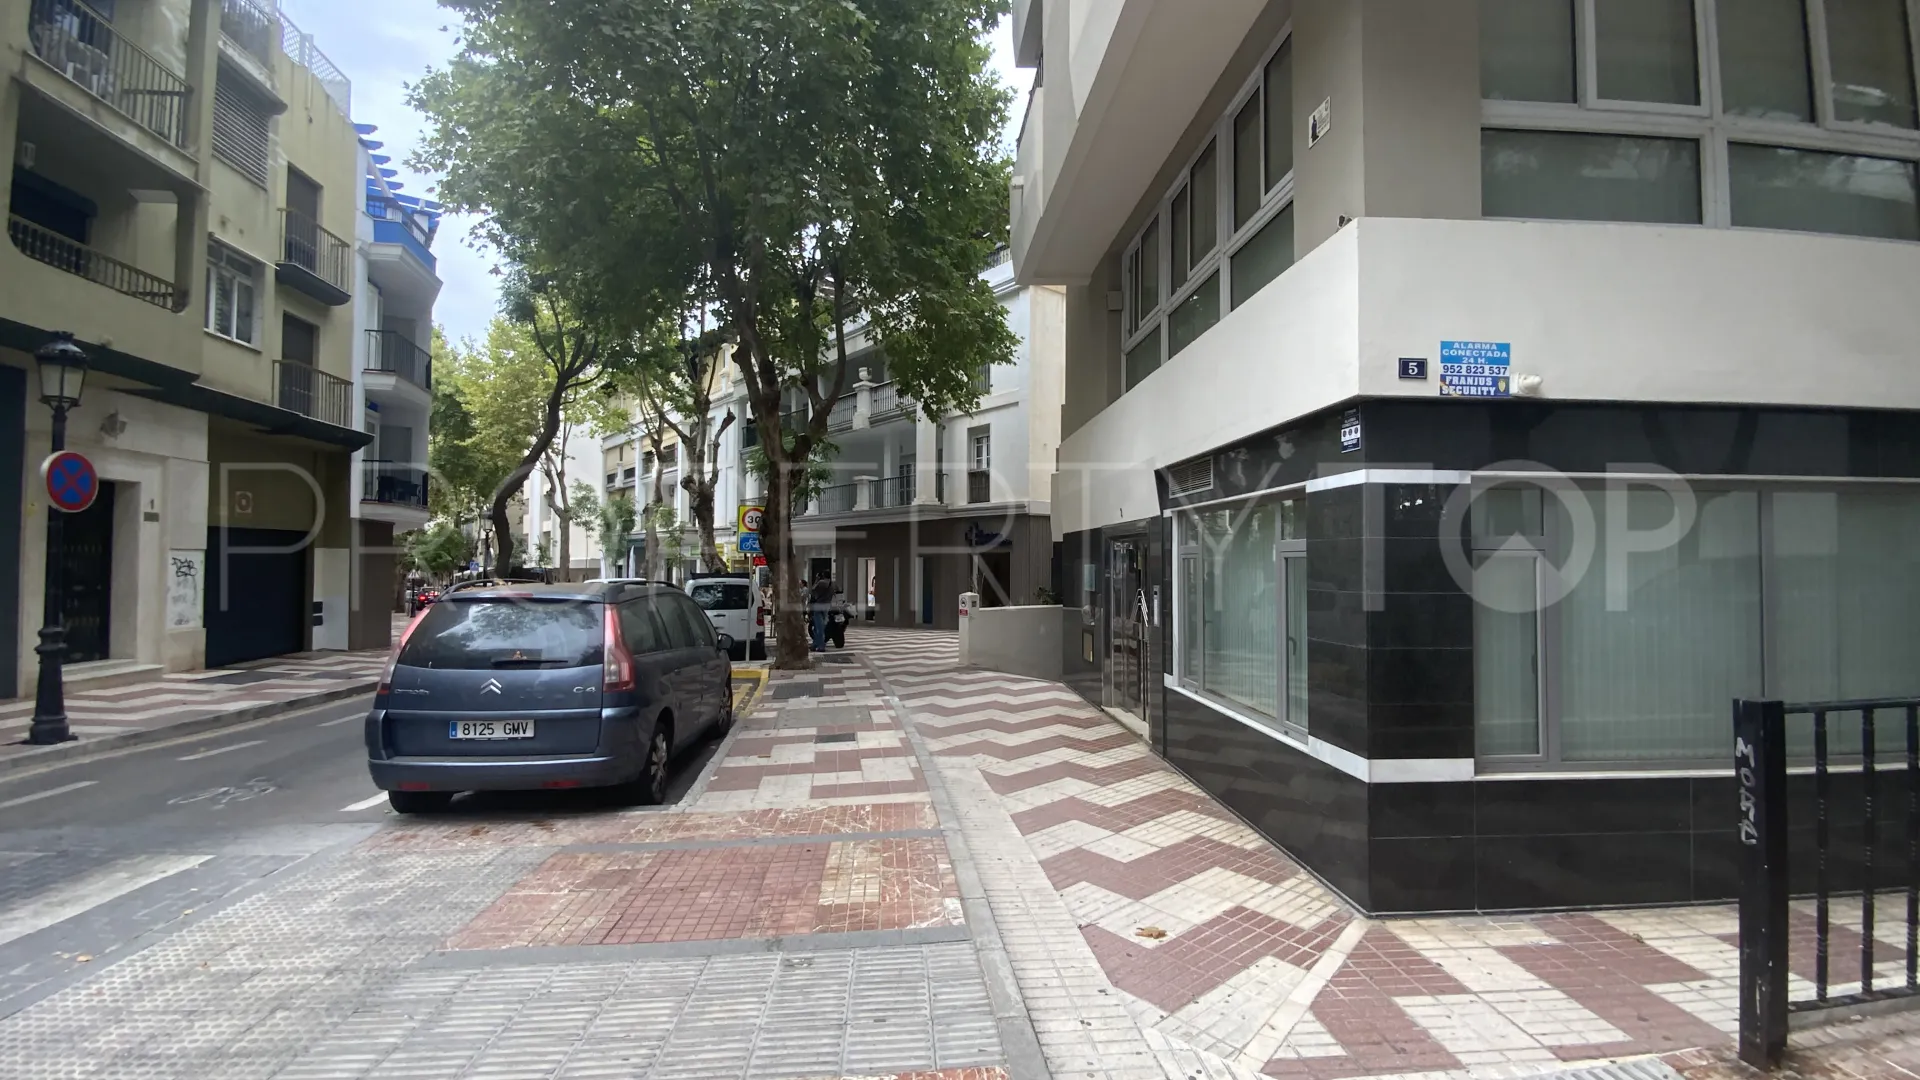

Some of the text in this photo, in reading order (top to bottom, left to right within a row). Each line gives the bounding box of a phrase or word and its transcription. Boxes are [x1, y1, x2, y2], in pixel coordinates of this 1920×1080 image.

[1453, 342, 1498, 350] ALARMA
[1442, 348, 1508, 358] CONECTADA
[1462, 356, 1489, 365] 24 H.
[1408, 361, 1418, 375] 5
[1442, 364, 1508, 376] 952 823 537
[1445, 376, 1492, 386] FRANJUS
[1442, 385, 1496, 395] SECURITY
[462, 721, 529, 736] 8125 GMV
